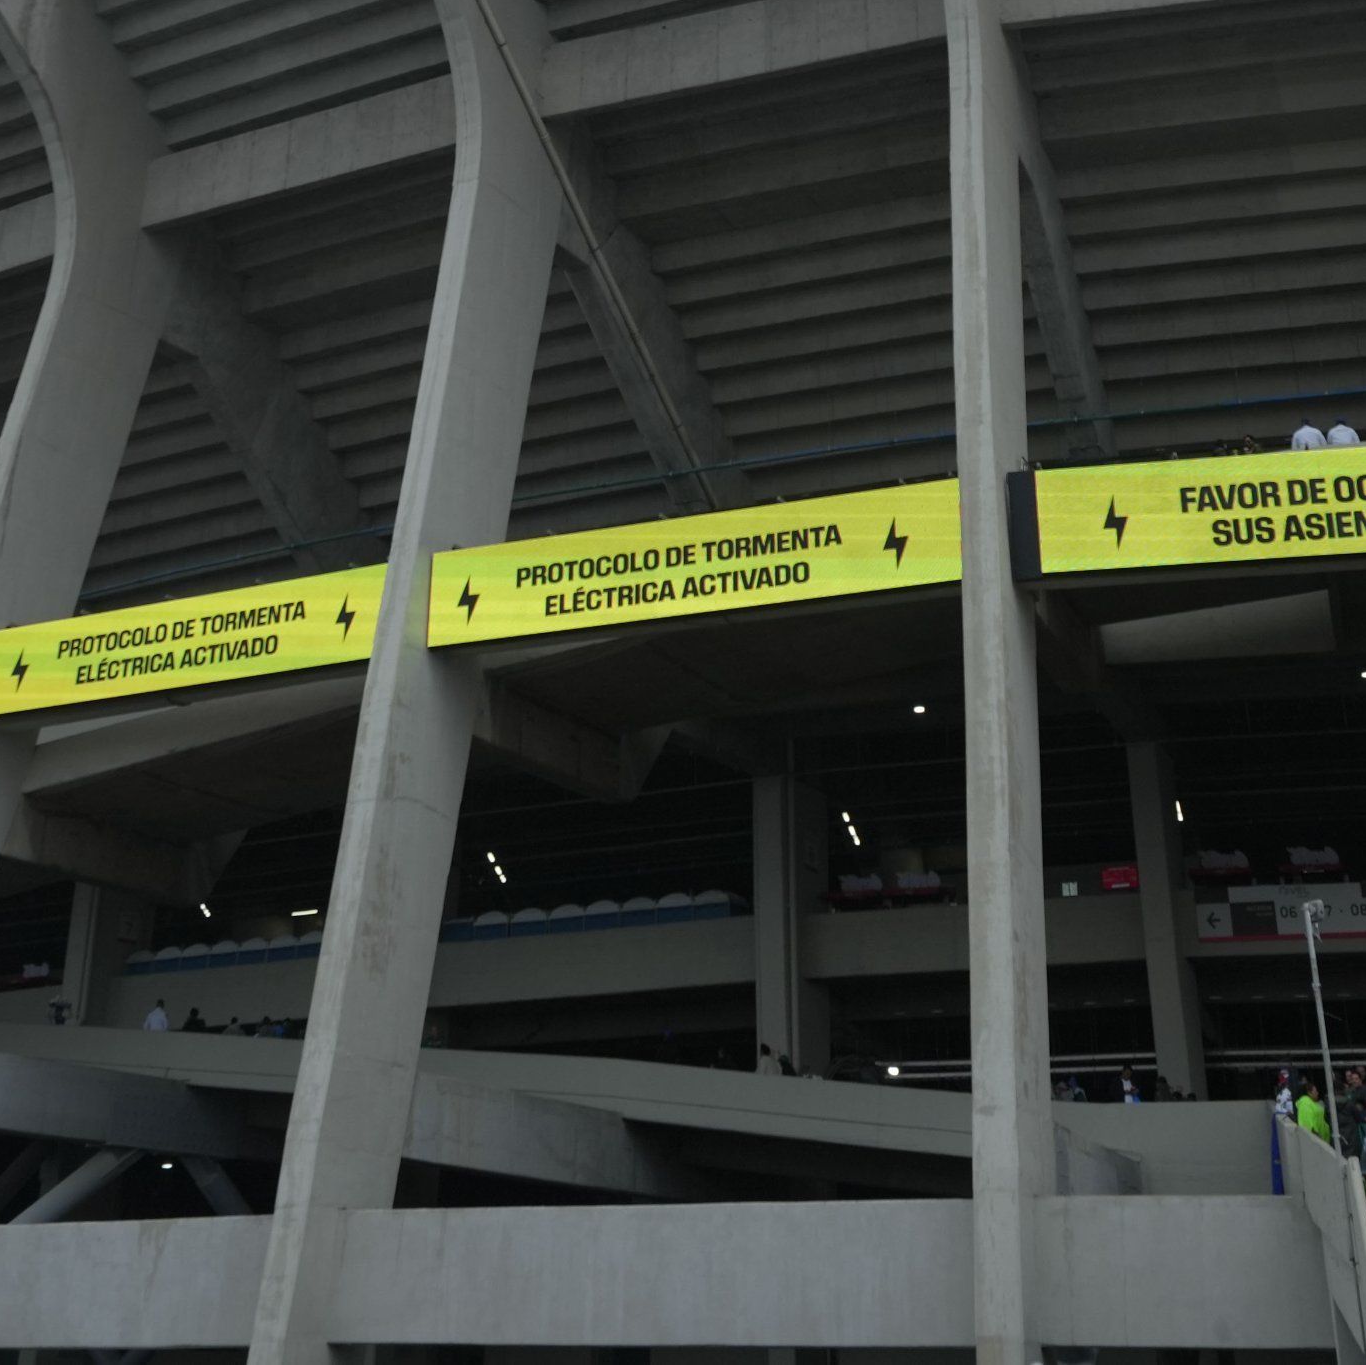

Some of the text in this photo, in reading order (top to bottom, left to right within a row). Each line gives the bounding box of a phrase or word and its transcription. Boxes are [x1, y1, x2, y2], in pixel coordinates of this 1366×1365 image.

[1179, 481, 1282, 514] FAVOR
[1286, 477, 1328, 506] DE
[516, 524, 842, 588] PROTOCOLO DE TORMENTA
[1211, 516, 1276, 547] SUS
[545, 561, 810, 617] ELÉCTRICA ACTIVADO
[57, 600, 306, 659] PROTOCOLO DE TORMENTA
[75, 634, 279, 685] ELÉCTRICA ACTIVADO
[1280, 906, 1298, 918] 06
